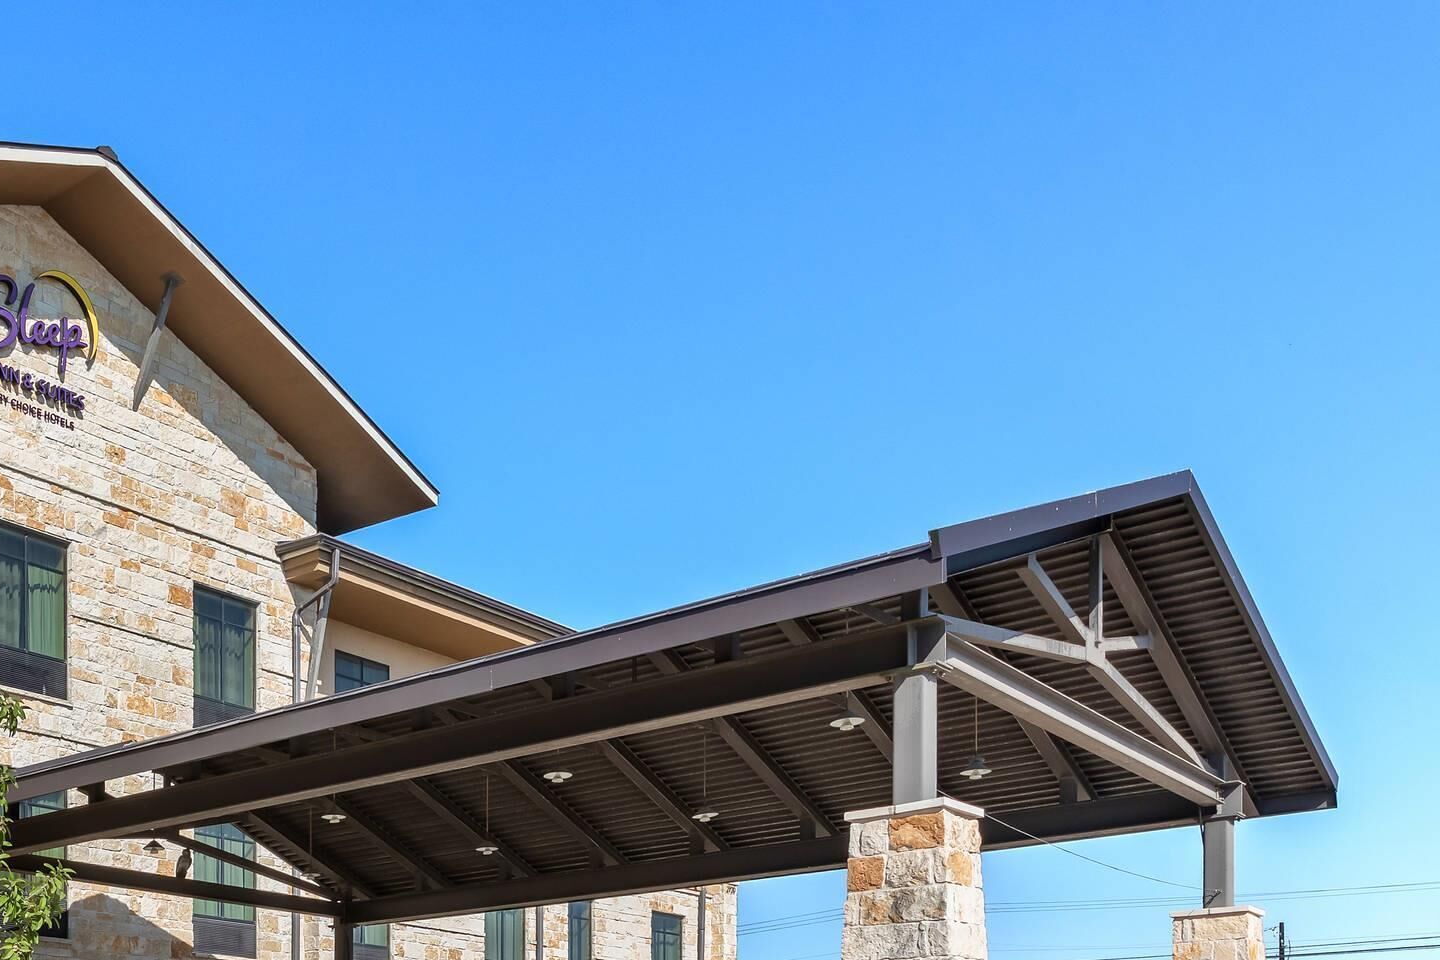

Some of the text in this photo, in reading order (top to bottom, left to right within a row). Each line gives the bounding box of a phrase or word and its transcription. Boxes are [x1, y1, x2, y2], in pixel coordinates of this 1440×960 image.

[22, 374, 34, 389] &
[38, 380, 86, 410] SUITES
[11, 398, 42, 420] CHOICE
[44, 409, 75, 431] HOTELS
